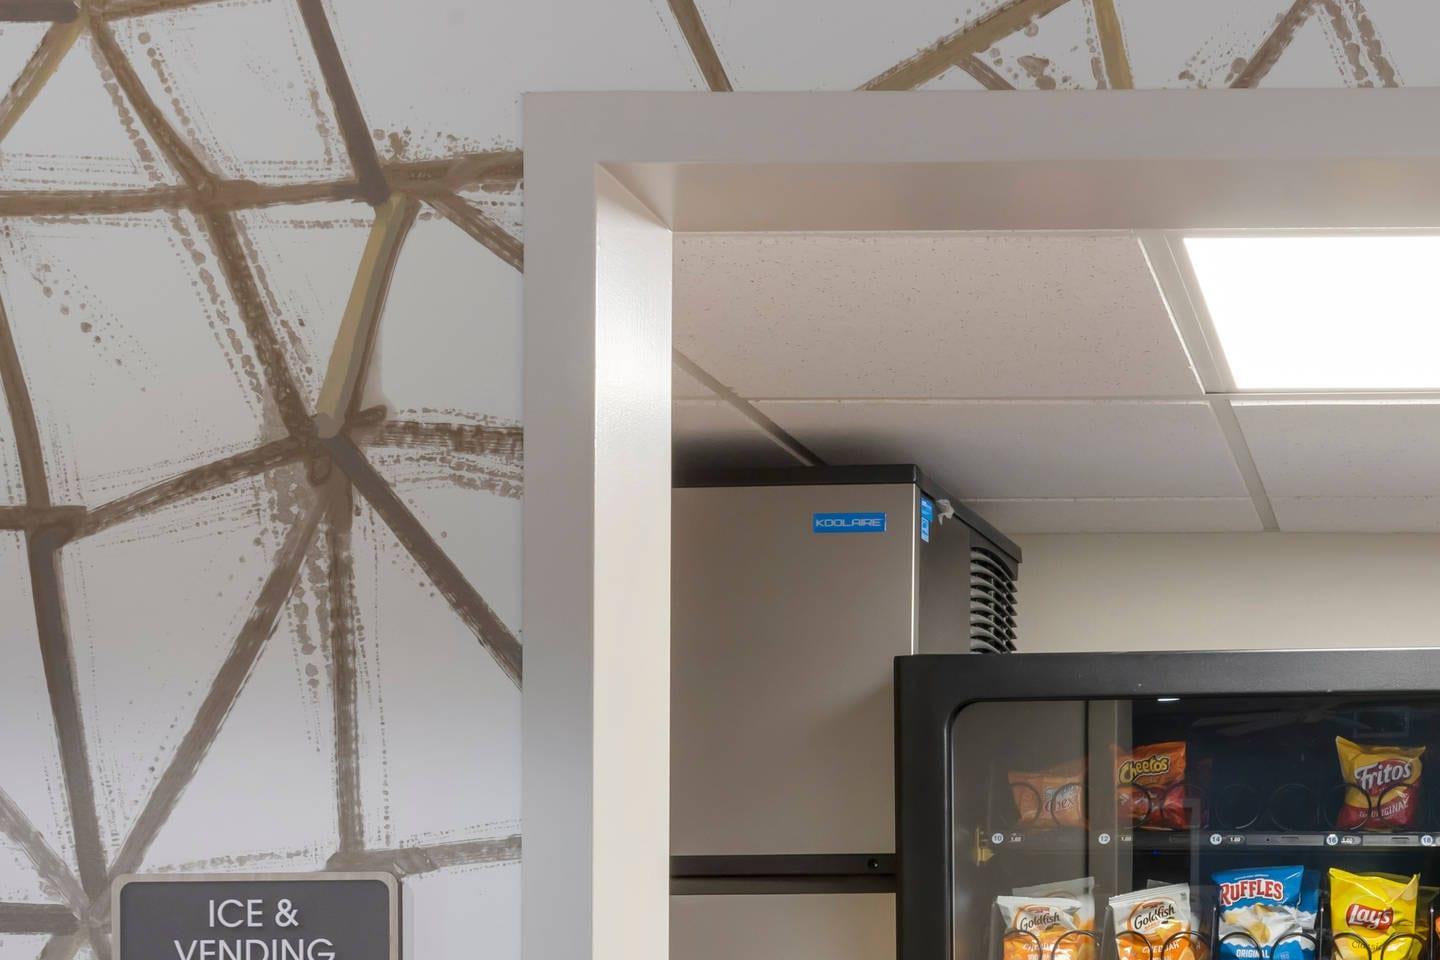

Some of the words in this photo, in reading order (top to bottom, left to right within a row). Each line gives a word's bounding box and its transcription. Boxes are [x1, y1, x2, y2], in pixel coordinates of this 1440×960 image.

[814, 518, 881, 527] KOOLAIRE
[1118, 756, 1169, 784] Cheetos
[1354, 761, 1412, 791] Fritos
[1220, 878, 1284, 906] RUFFLES
[209, 899, 263, 928] ICE
[275, 898, 300, 927] &
[1020, 911, 1060, 932] Goldfish
[1134, 904, 1175, 930] Goldfish
